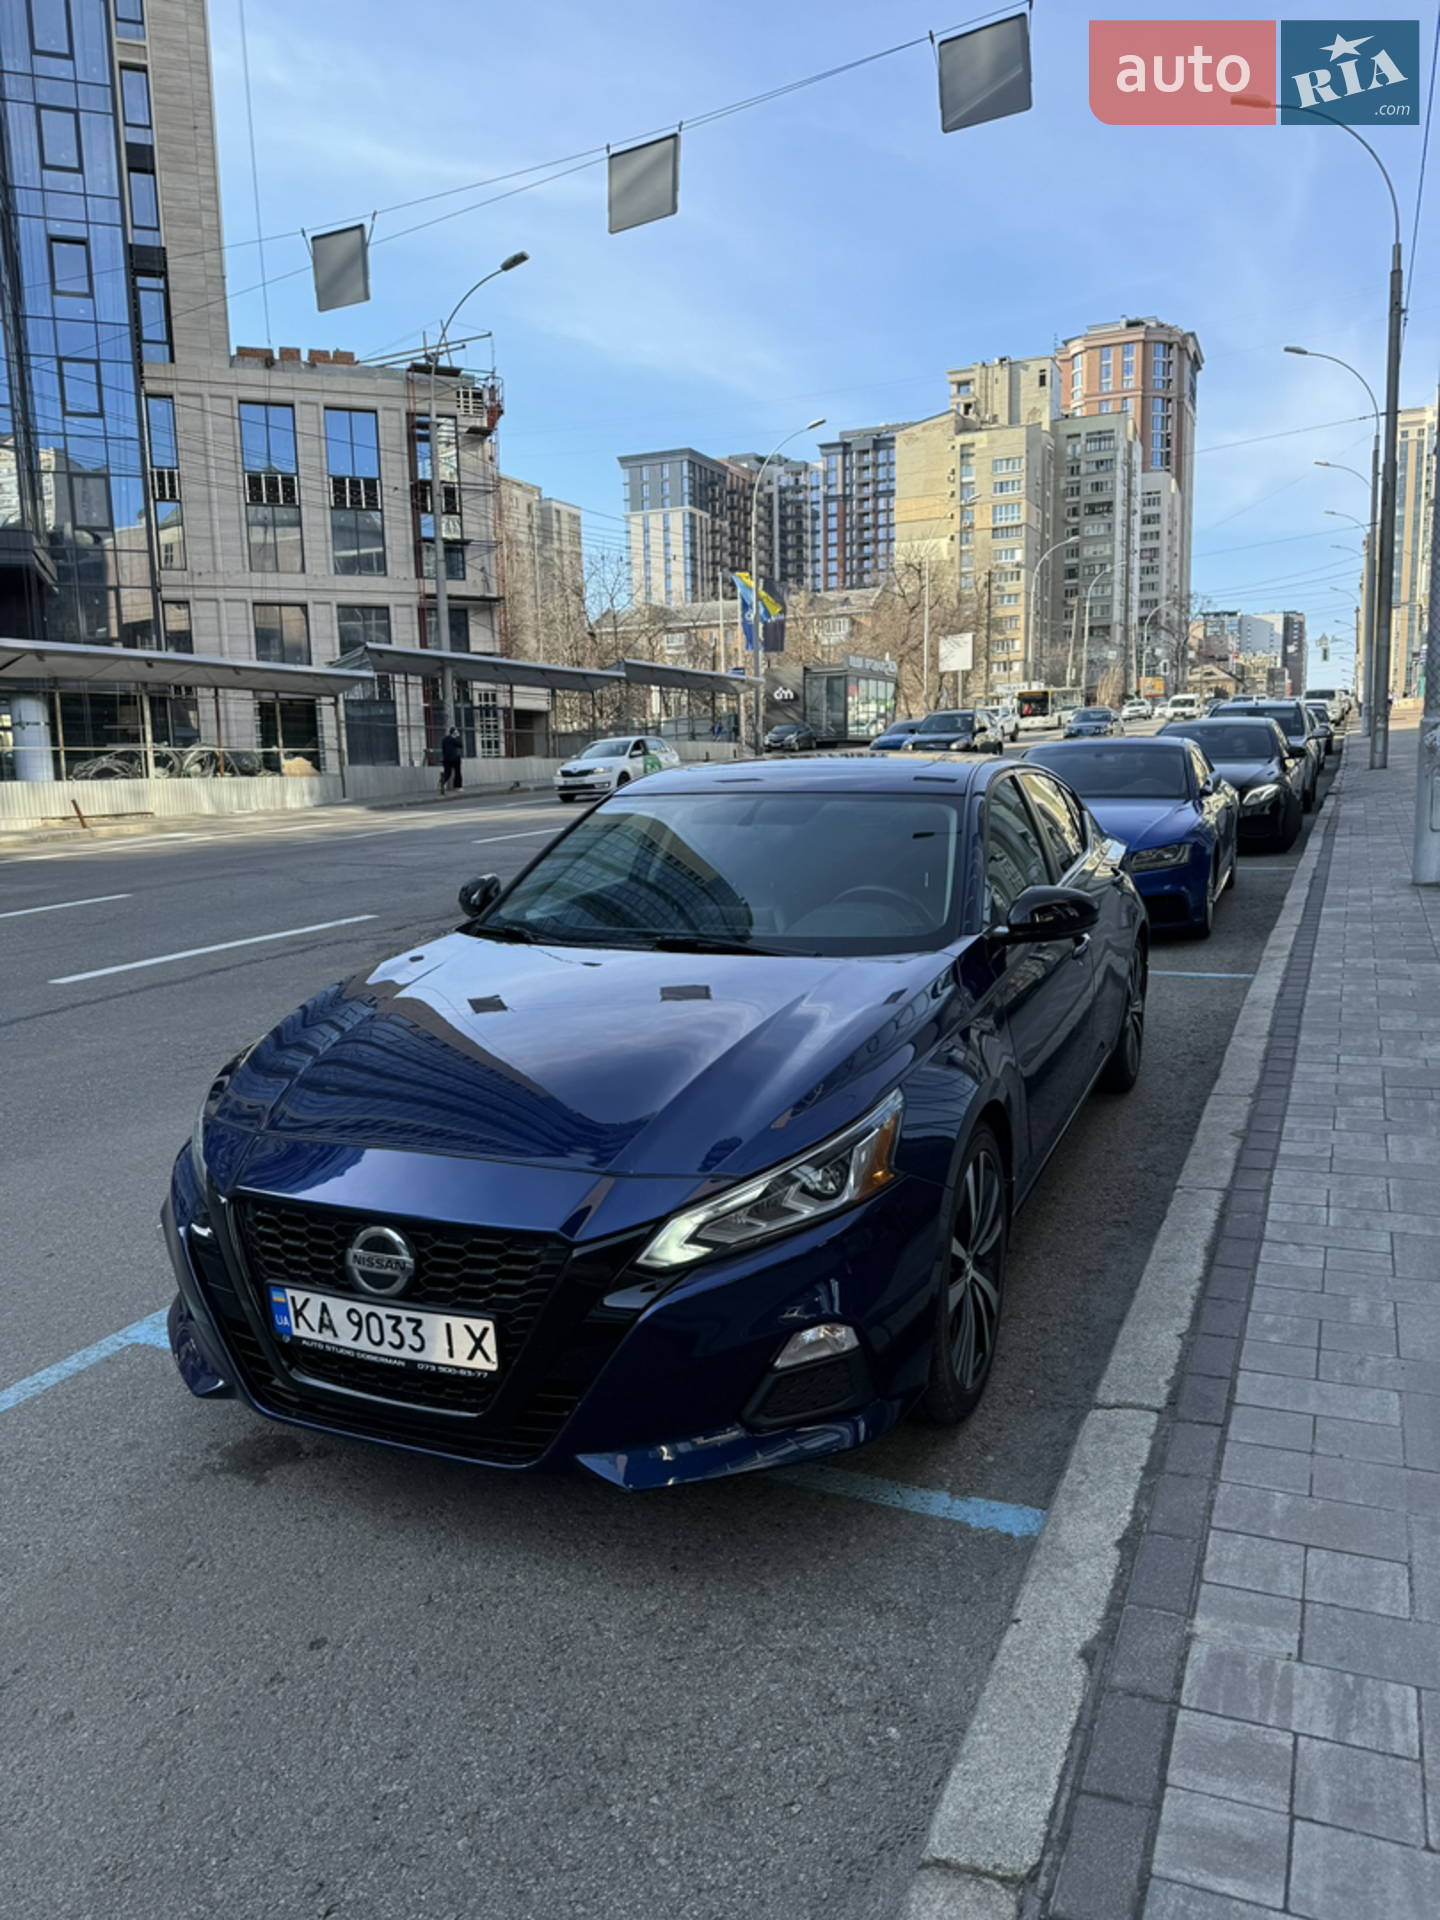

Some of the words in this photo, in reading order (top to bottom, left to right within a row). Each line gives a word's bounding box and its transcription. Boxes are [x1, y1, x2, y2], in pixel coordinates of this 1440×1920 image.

[352, 1253, 407, 1271] NISSAN
[275, 1314, 290, 1327] UA
[290, 1295, 338, 1338] KA
[346, 1307, 426, 1353] 9033
[445, 1322, 494, 1363] IX
[301, 1339, 324, 1350] AUTO
[324, 1344, 355, 1358] STUDIO
